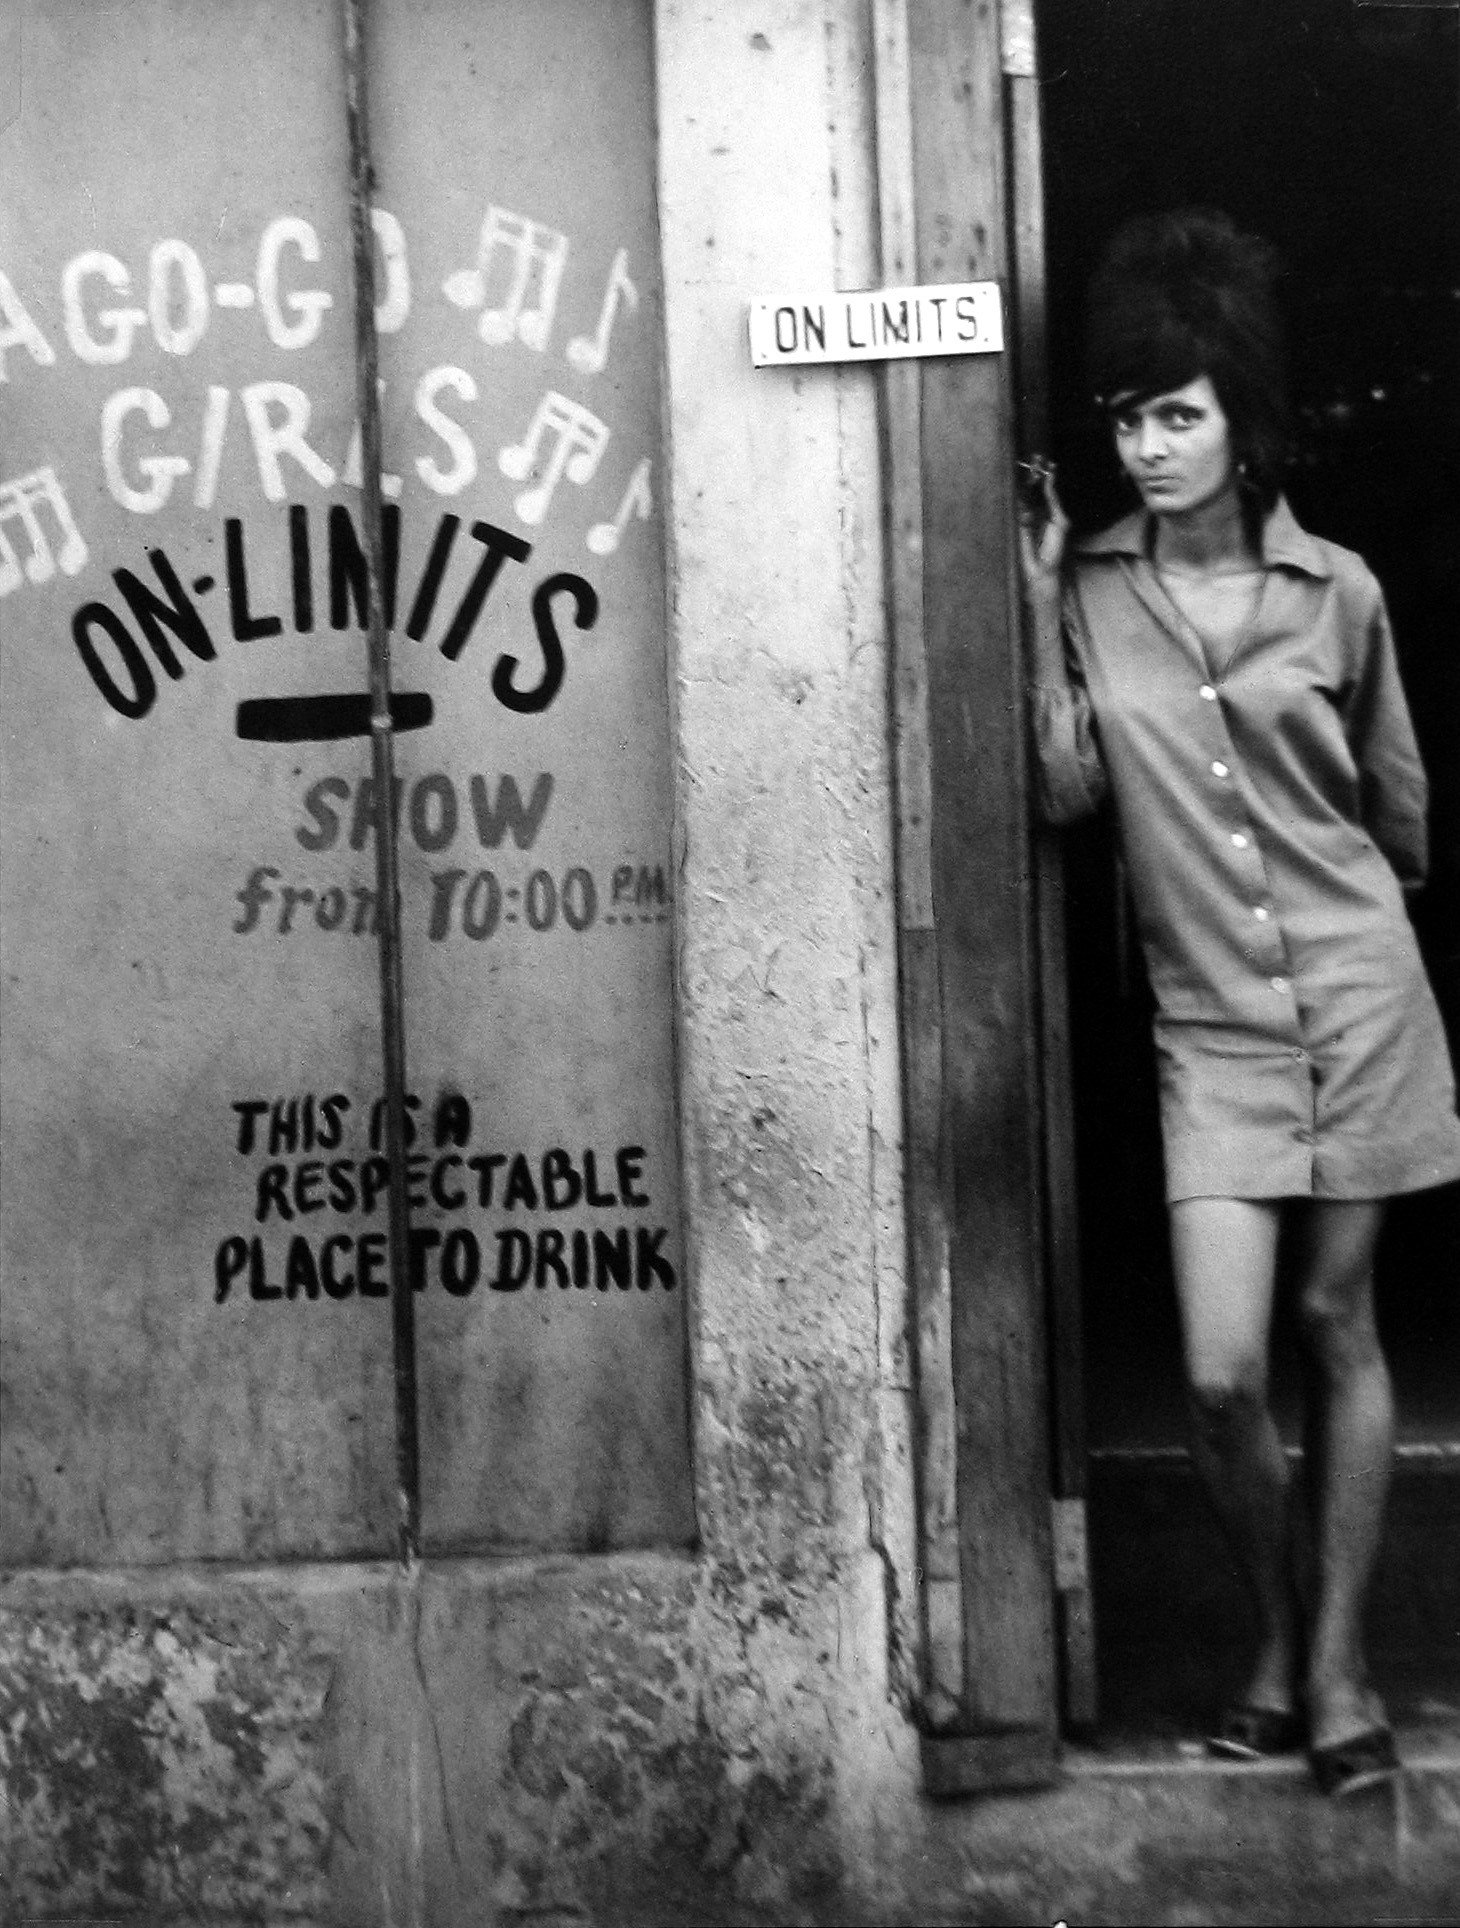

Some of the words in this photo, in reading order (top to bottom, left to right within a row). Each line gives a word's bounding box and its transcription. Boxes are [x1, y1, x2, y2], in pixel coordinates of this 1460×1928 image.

[774, 306, 826, 353] ON
[846, 296, 978, 348] LIMITS
[296, 772, 554, 854] SHOW
[232, 1094, 350, 1154] THIS
[433, 1093, 472, 1148] A
[256, 1146, 650, 1222] RESPECTABLE
[214, 1232, 390, 1304] PLACE
[400, 1228, 480, 1297] TO
[489, 1226, 677, 1293] DRINK
